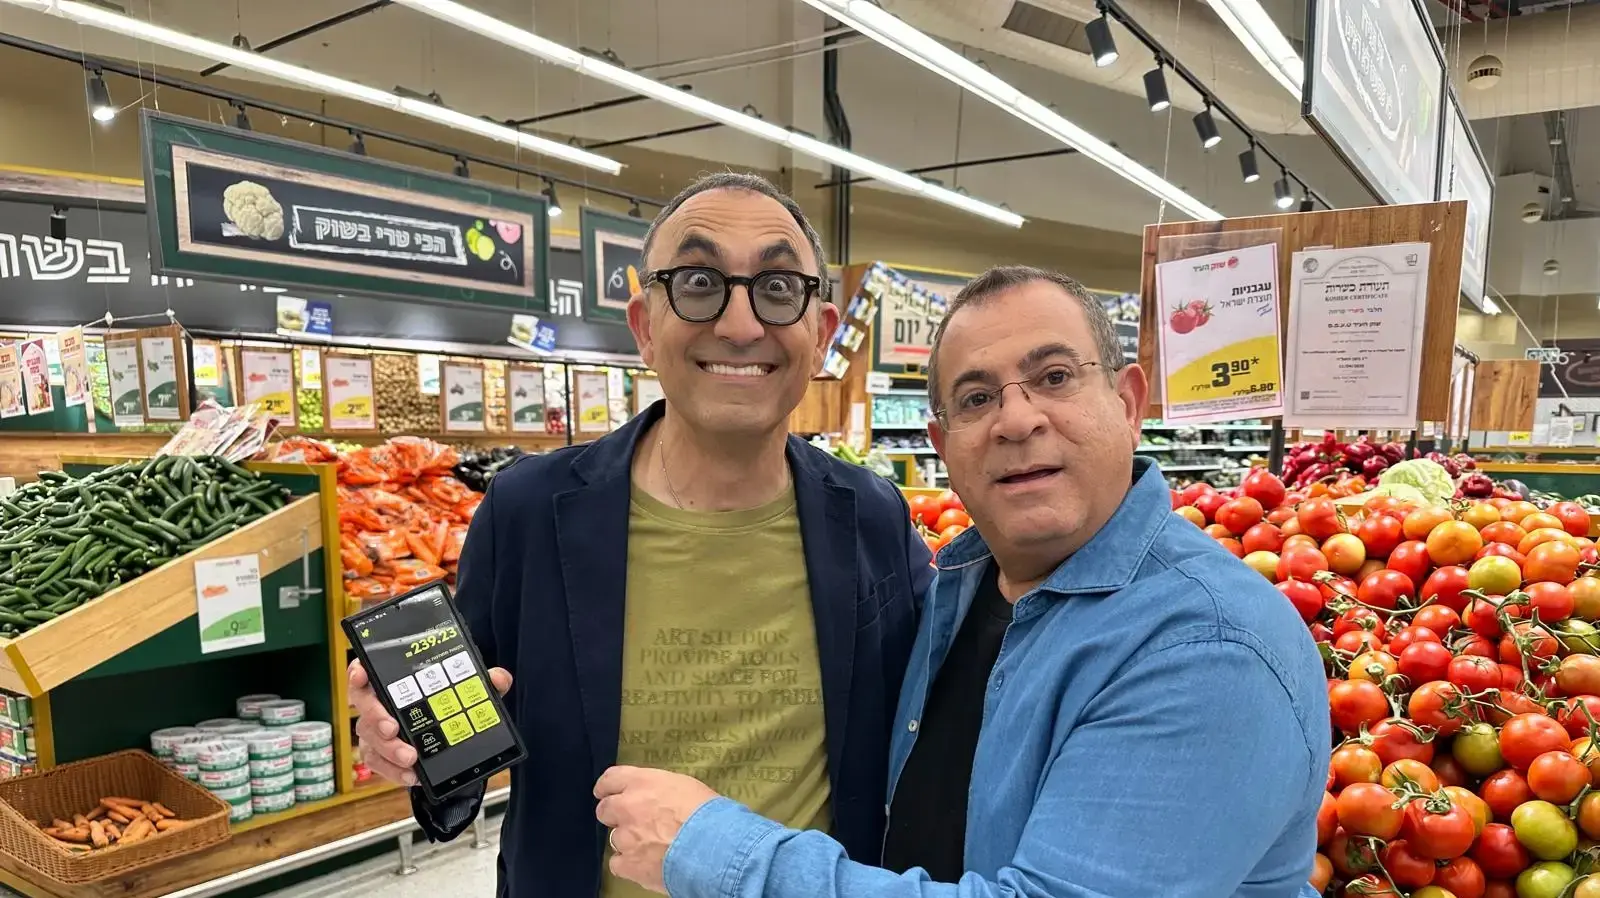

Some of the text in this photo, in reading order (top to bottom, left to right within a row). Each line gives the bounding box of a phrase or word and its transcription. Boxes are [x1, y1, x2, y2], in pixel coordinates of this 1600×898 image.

[315, 216, 447, 254] הכי טרי בשוק
[0, 232, 131, 283] בשו
[1231, 281, 1272, 297] עגבניות
[1325, 283, 1356, 294] כשרות
[1220, 293, 1273, 308] תוצרת ישראל
[894, 318, 920, 344] יום
[411, 627, 457, 655] 239.23
[653, 627, 790, 646] ART STUDIOS
[640, 649, 800, 666] PROVIDE TOOLS
[642, 668, 800, 686] AND SPACE FOR
[621, 687, 823, 706] REATIVITY TO TRUL
[663, 727, 740, 744] SPACES
